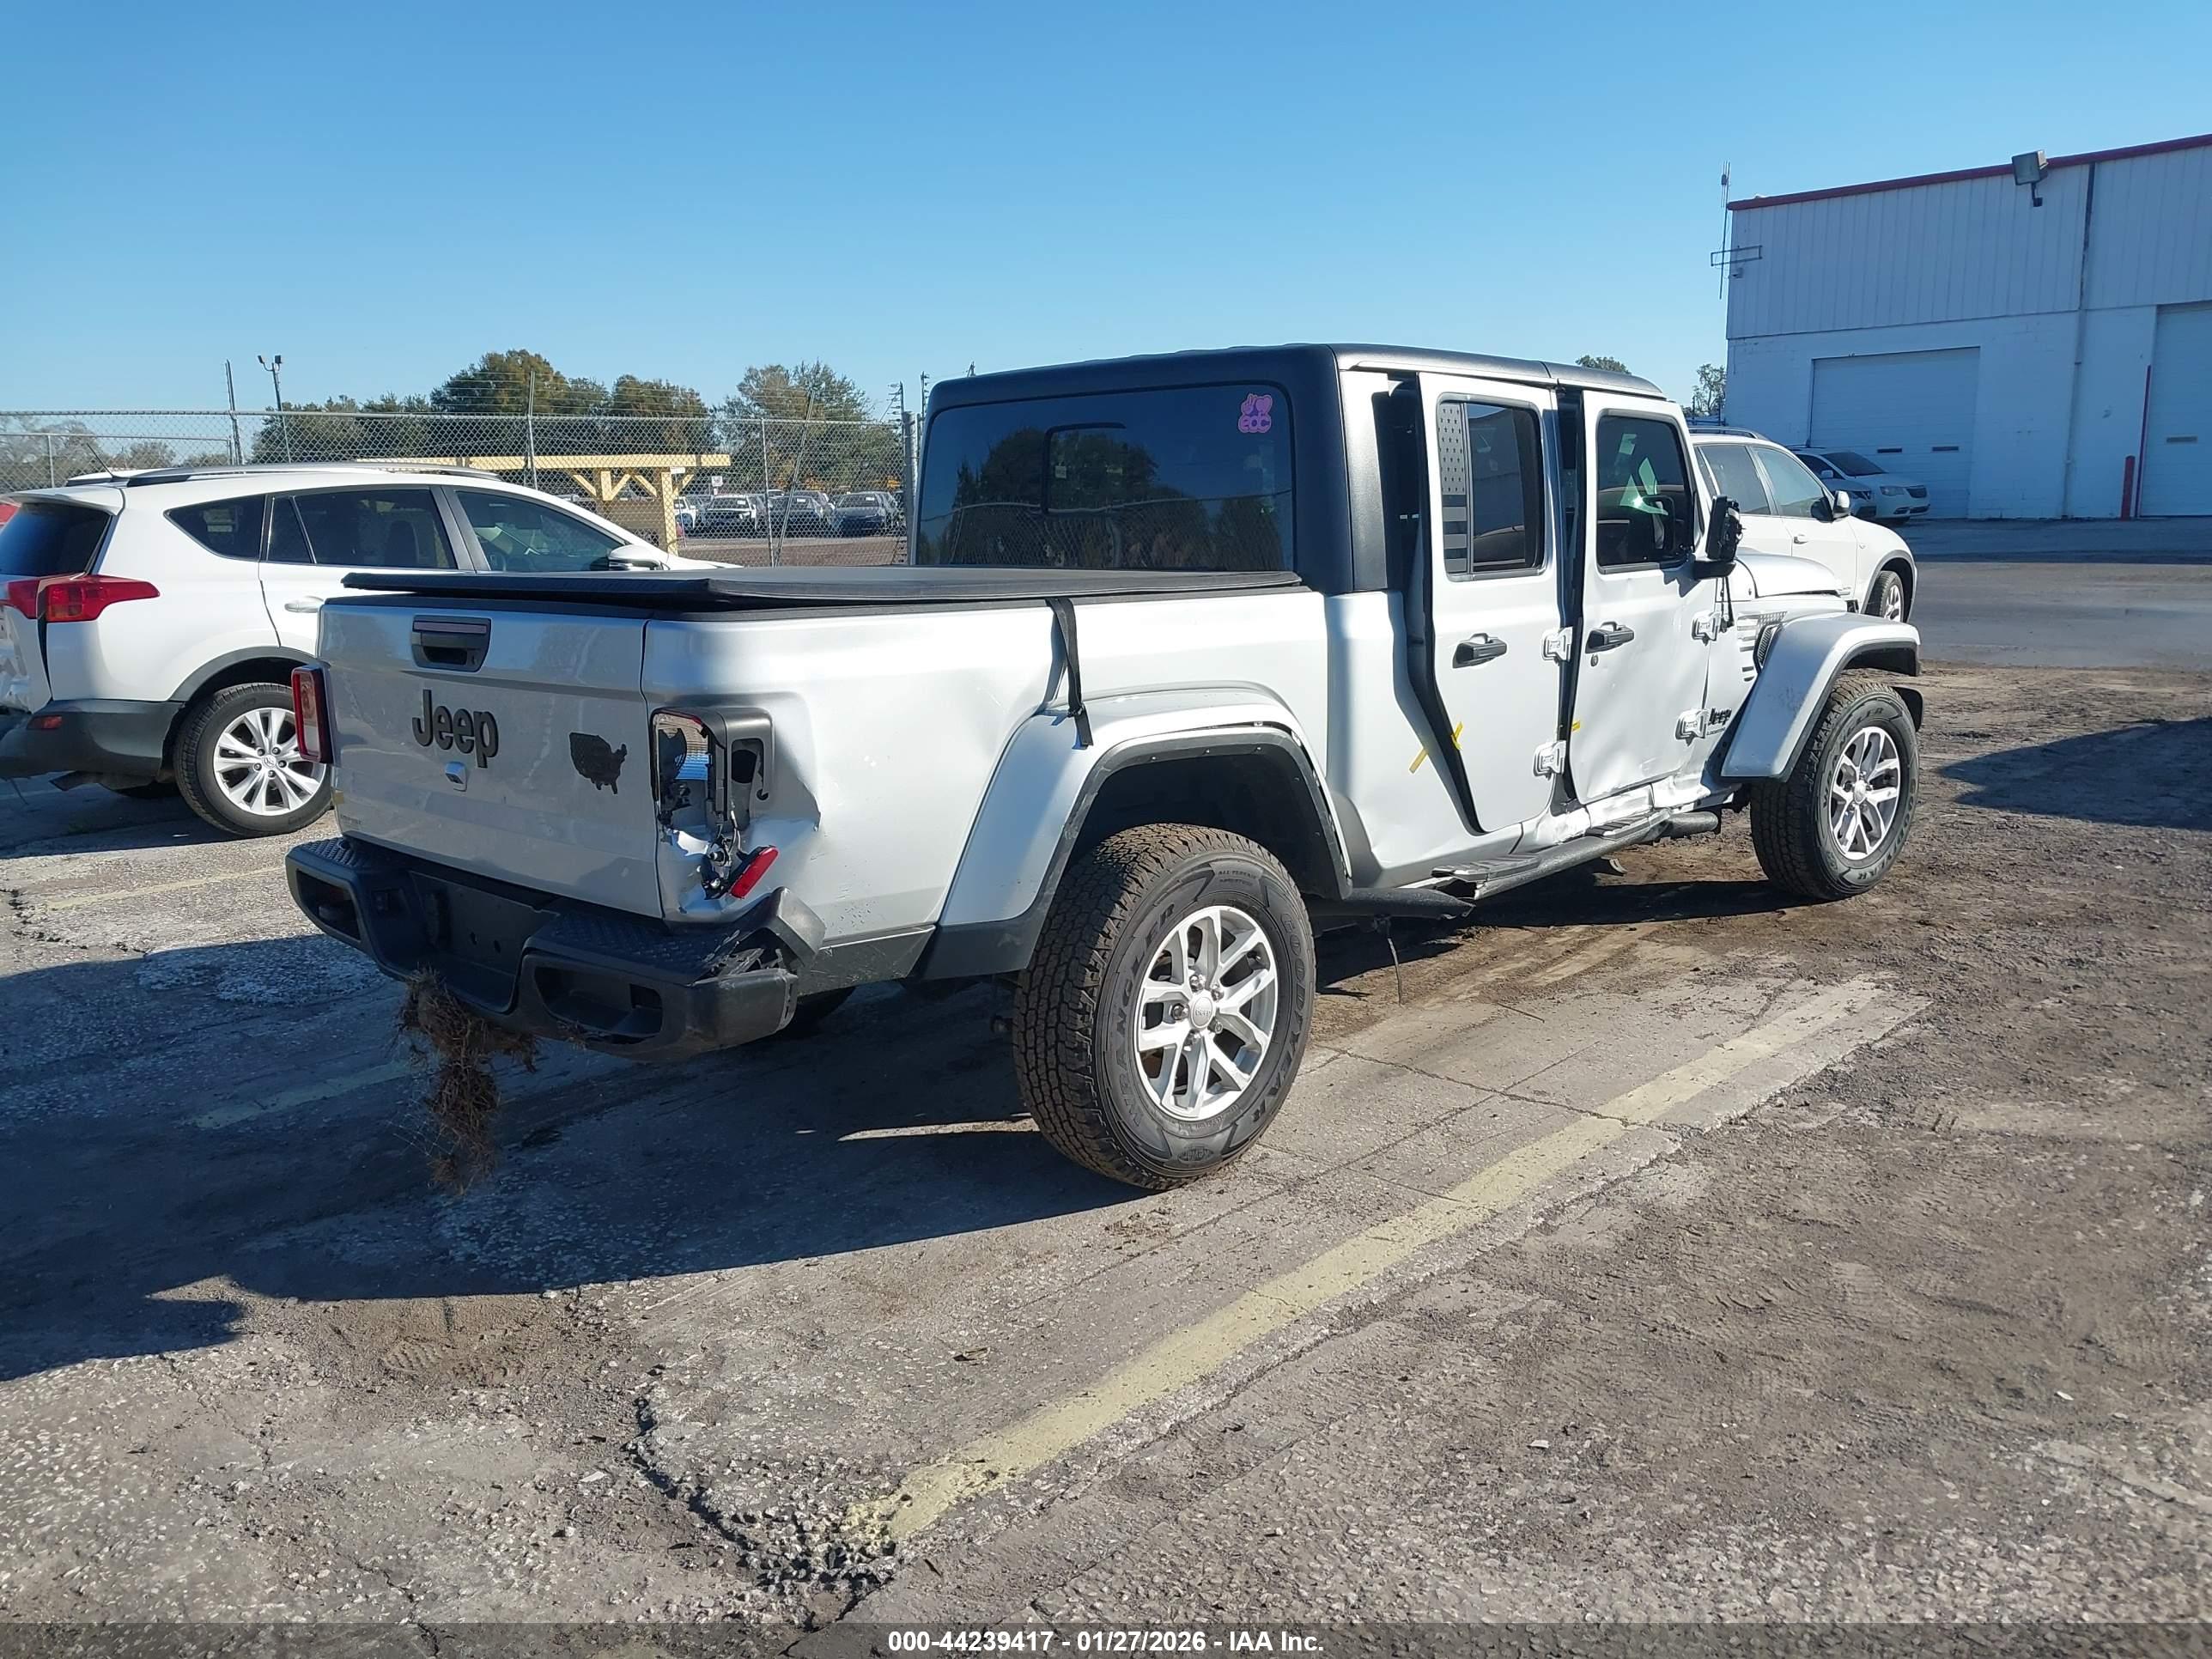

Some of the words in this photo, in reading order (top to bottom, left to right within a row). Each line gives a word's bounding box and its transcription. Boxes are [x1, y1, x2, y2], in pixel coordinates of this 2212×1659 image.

[412, 689, 499, 769] Jeep
[1708, 708, 1732, 726] Jeep
[1253, 913, 1306, 1122] GOODYEAR
